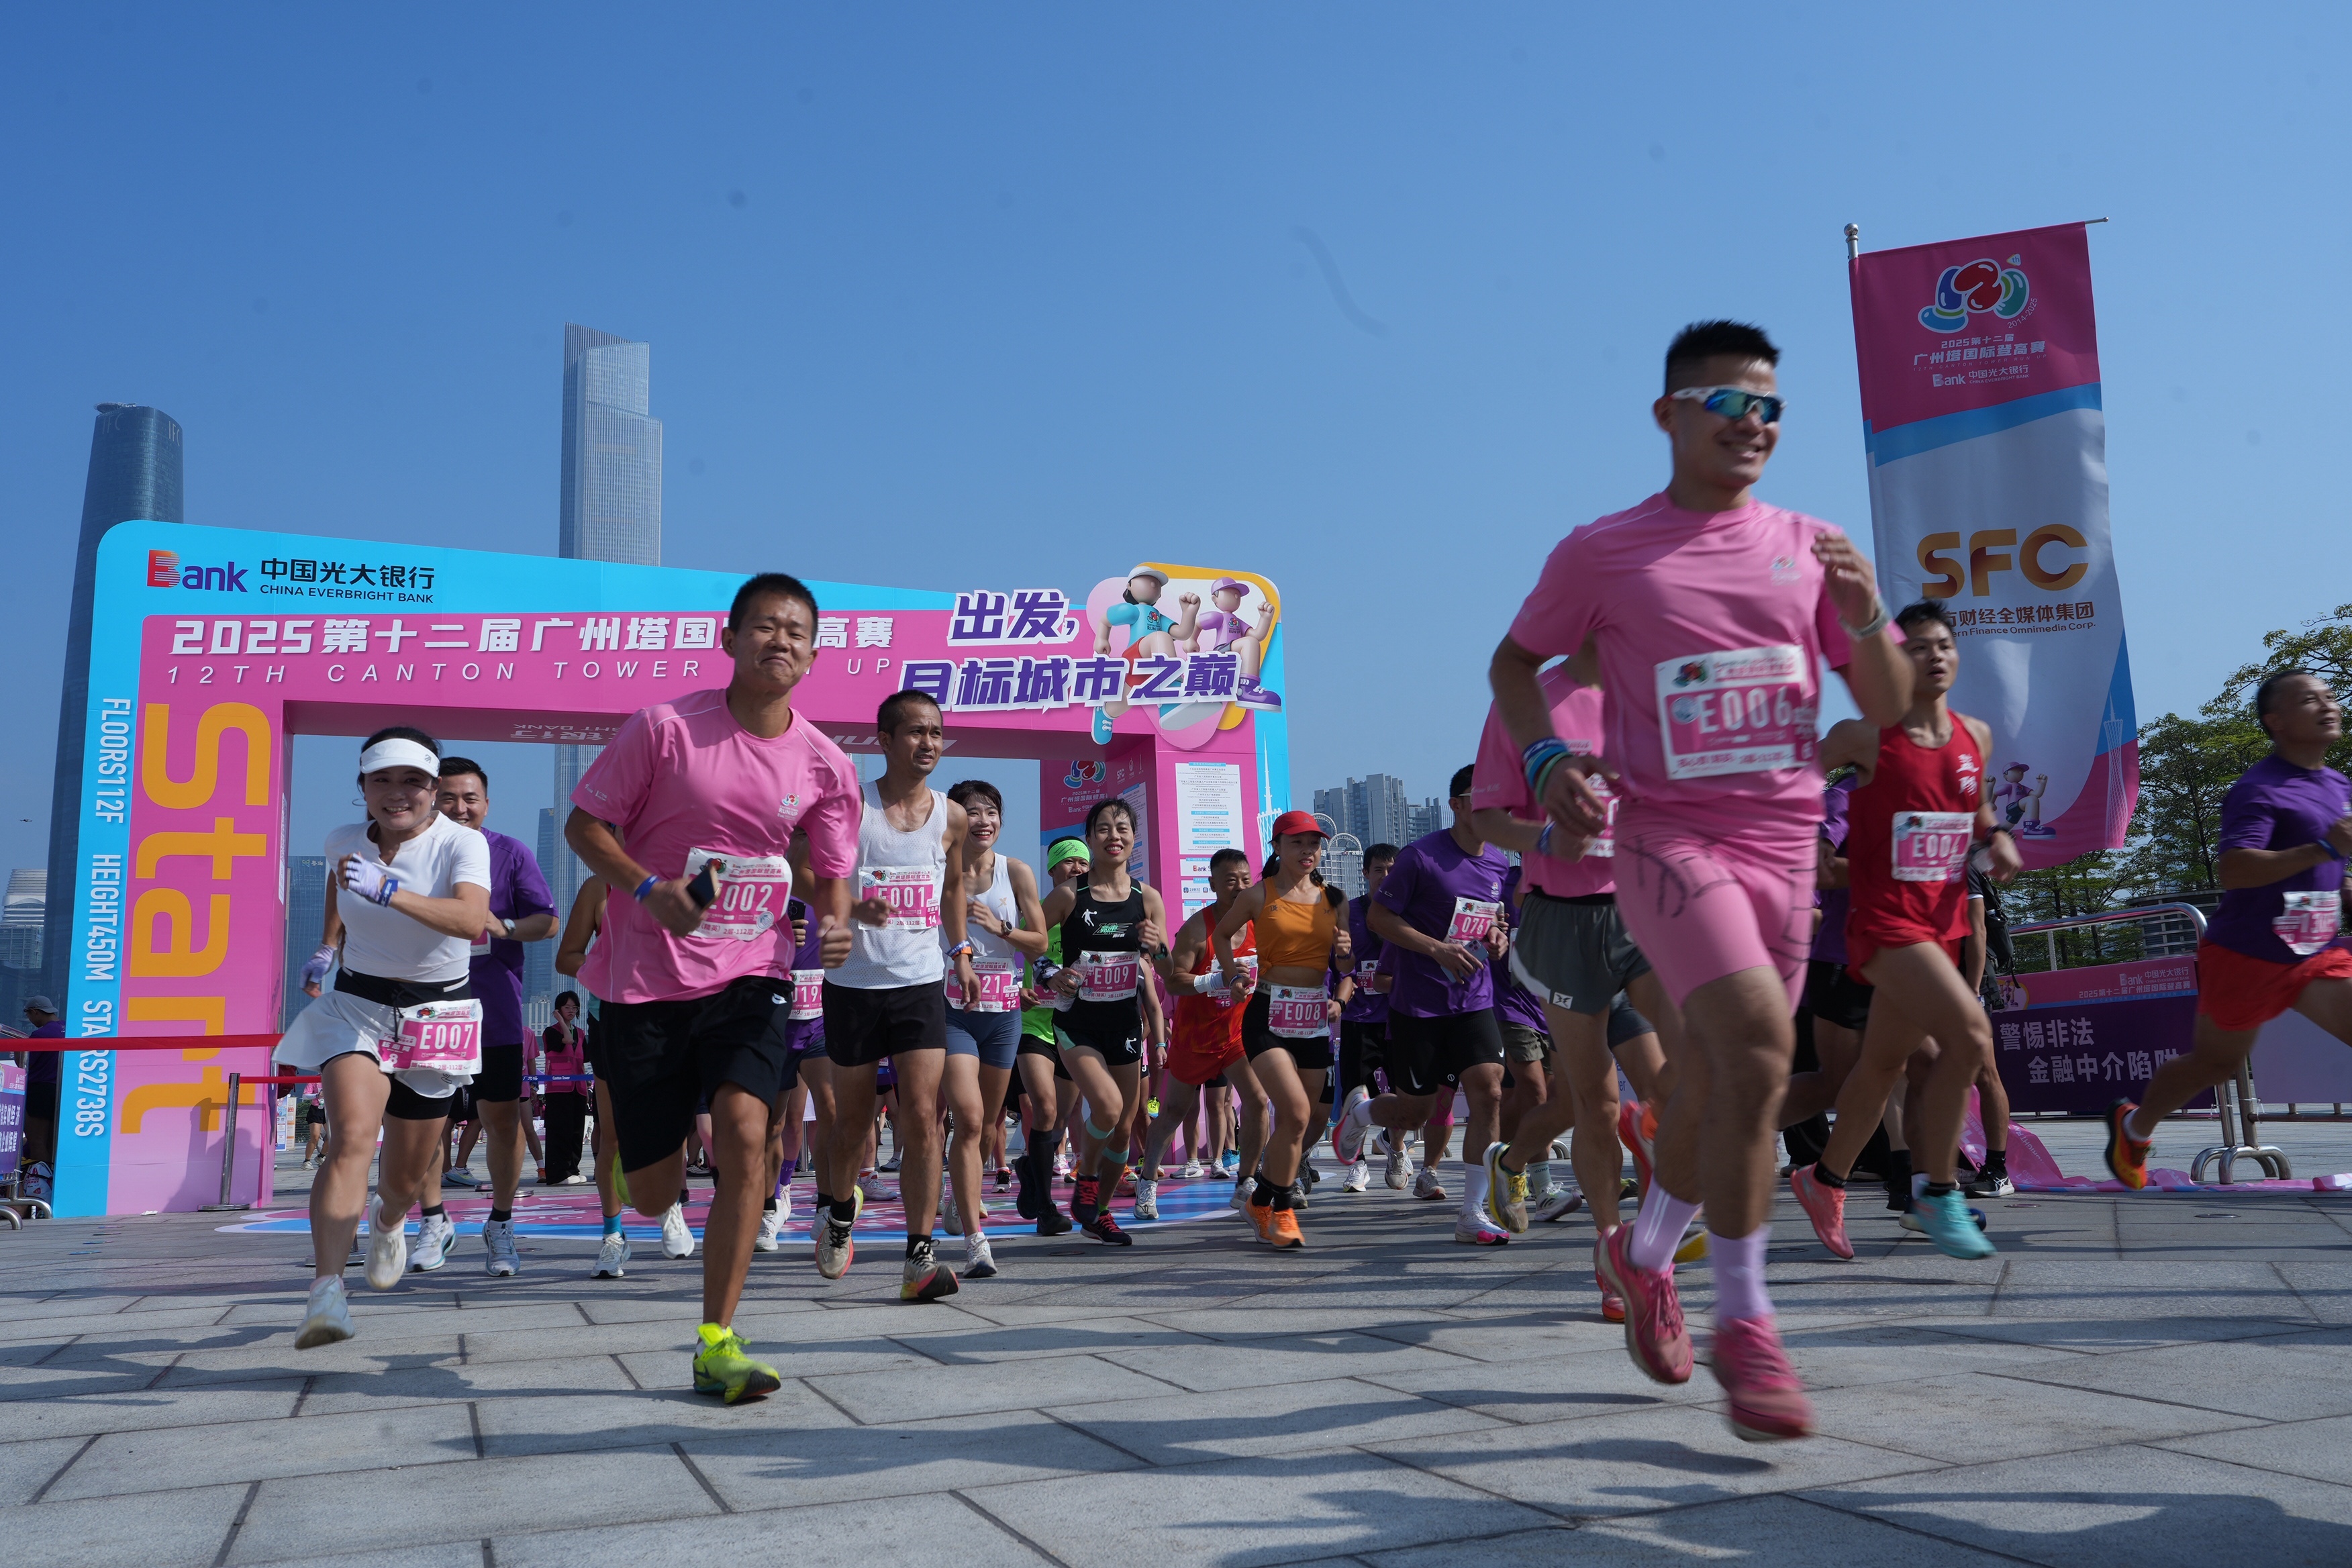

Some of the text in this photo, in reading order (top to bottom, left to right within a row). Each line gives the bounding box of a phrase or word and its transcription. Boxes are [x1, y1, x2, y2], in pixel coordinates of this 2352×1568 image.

[2007, 297, 2038, 329] 2014-2025
[1913, 340, 2045, 366] 广州塔国际登高赛
[1941, 334, 2014, 349] 2025第十二届
[1932, 373, 1967, 387] Bank
[1968, 364, 2029, 379] 中国光大银行
[147, 549, 249, 592] Bank
[260, 558, 435, 589] 中国光大银行
[1916, 524, 2089, 598] SFC
[260, 585, 434, 603] CHINA EVERBRIGHT BANK
[1945, 601, 2094, 628] 方财经全媒体集团
[168, 616, 893, 655] 2025第十二届广州塔国高赛
[1970, 628, 2008, 636] Finance
[2010, 624, 2067, 634] Omnimedia
[2069, 622, 2096, 630] Corp.
[167, 658, 891, 684] 12TH CANTON TOWER UP
[902, 652, 1238, 704] 目标城市之巅
[1698, 685, 1794, 734] E006
[95, 697, 131, 824] FLOORS112F
[708, 882, 773, 912] 002
[85, 854, 121, 981] HEIGHT450M
[120, 701, 272, 1134] Start
[928, 914, 937, 925] 14
[1461, 916, 1491, 936] 0761
[1094, 966, 1130, 985] E009
[2144, 967, 2189, 979] 中国光大银行
[791, 985, 822, 1003] 019
[2079, 981, 2191, 999] 2025第十二届广州塔国际登高赛
[1007, 1000, 1016, 1008] 12
[1284, 1003, 1321, 1021] E008
[419, 1024, 474, 1050] E007
[2000, 1016, 2095, 1051] 警惕非法
[75, 999, 112, 1137] STARS2738S
